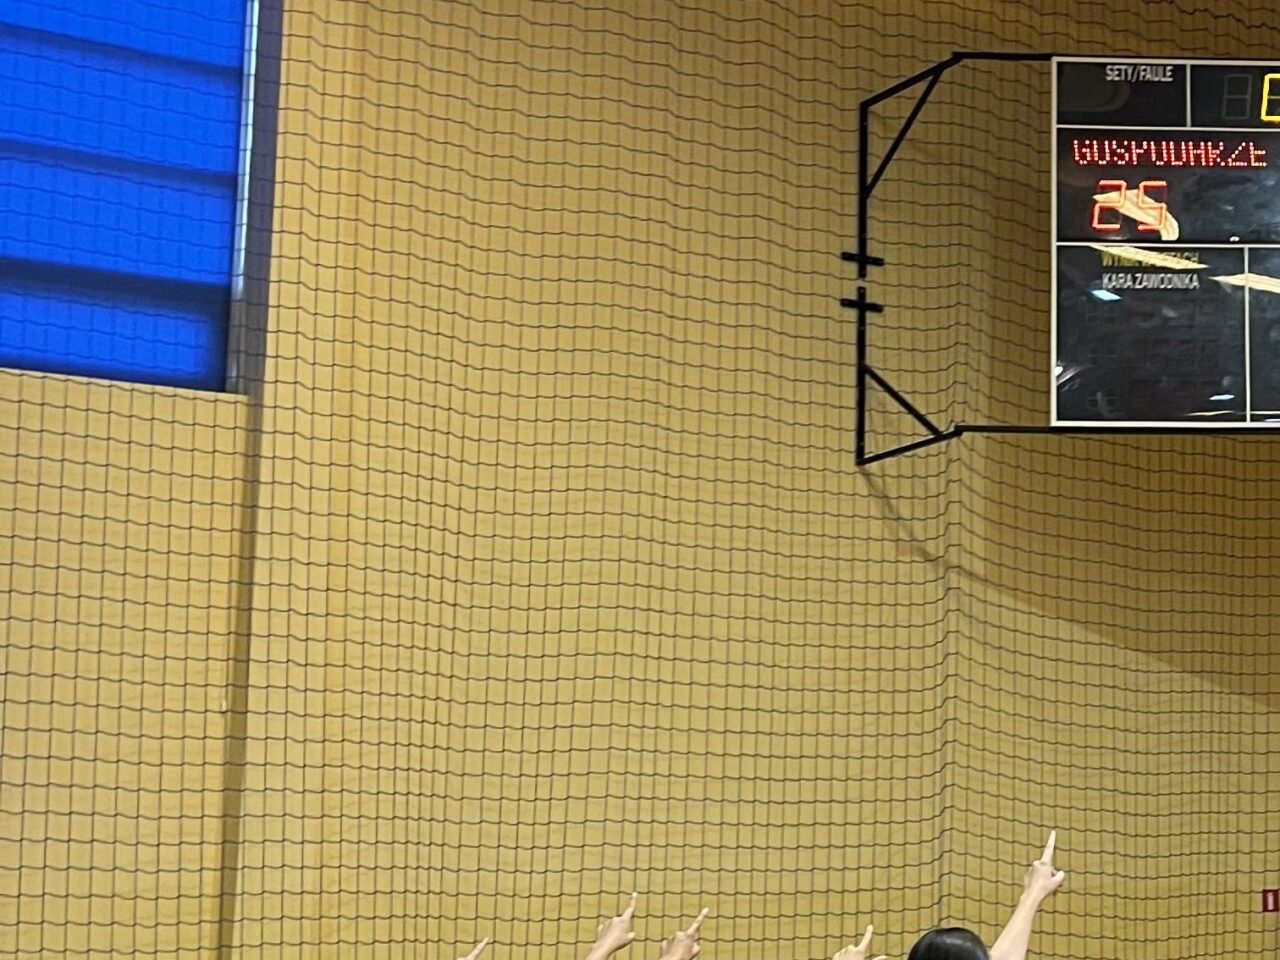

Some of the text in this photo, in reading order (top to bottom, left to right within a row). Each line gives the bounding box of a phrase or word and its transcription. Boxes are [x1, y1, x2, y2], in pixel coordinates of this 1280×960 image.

[1105, 65, 1174, 82] SETY/FAULE
[1091, 179, 1168, 232] 25
[1102, 273, 1200, 289] KARA ZAWODNIKA
